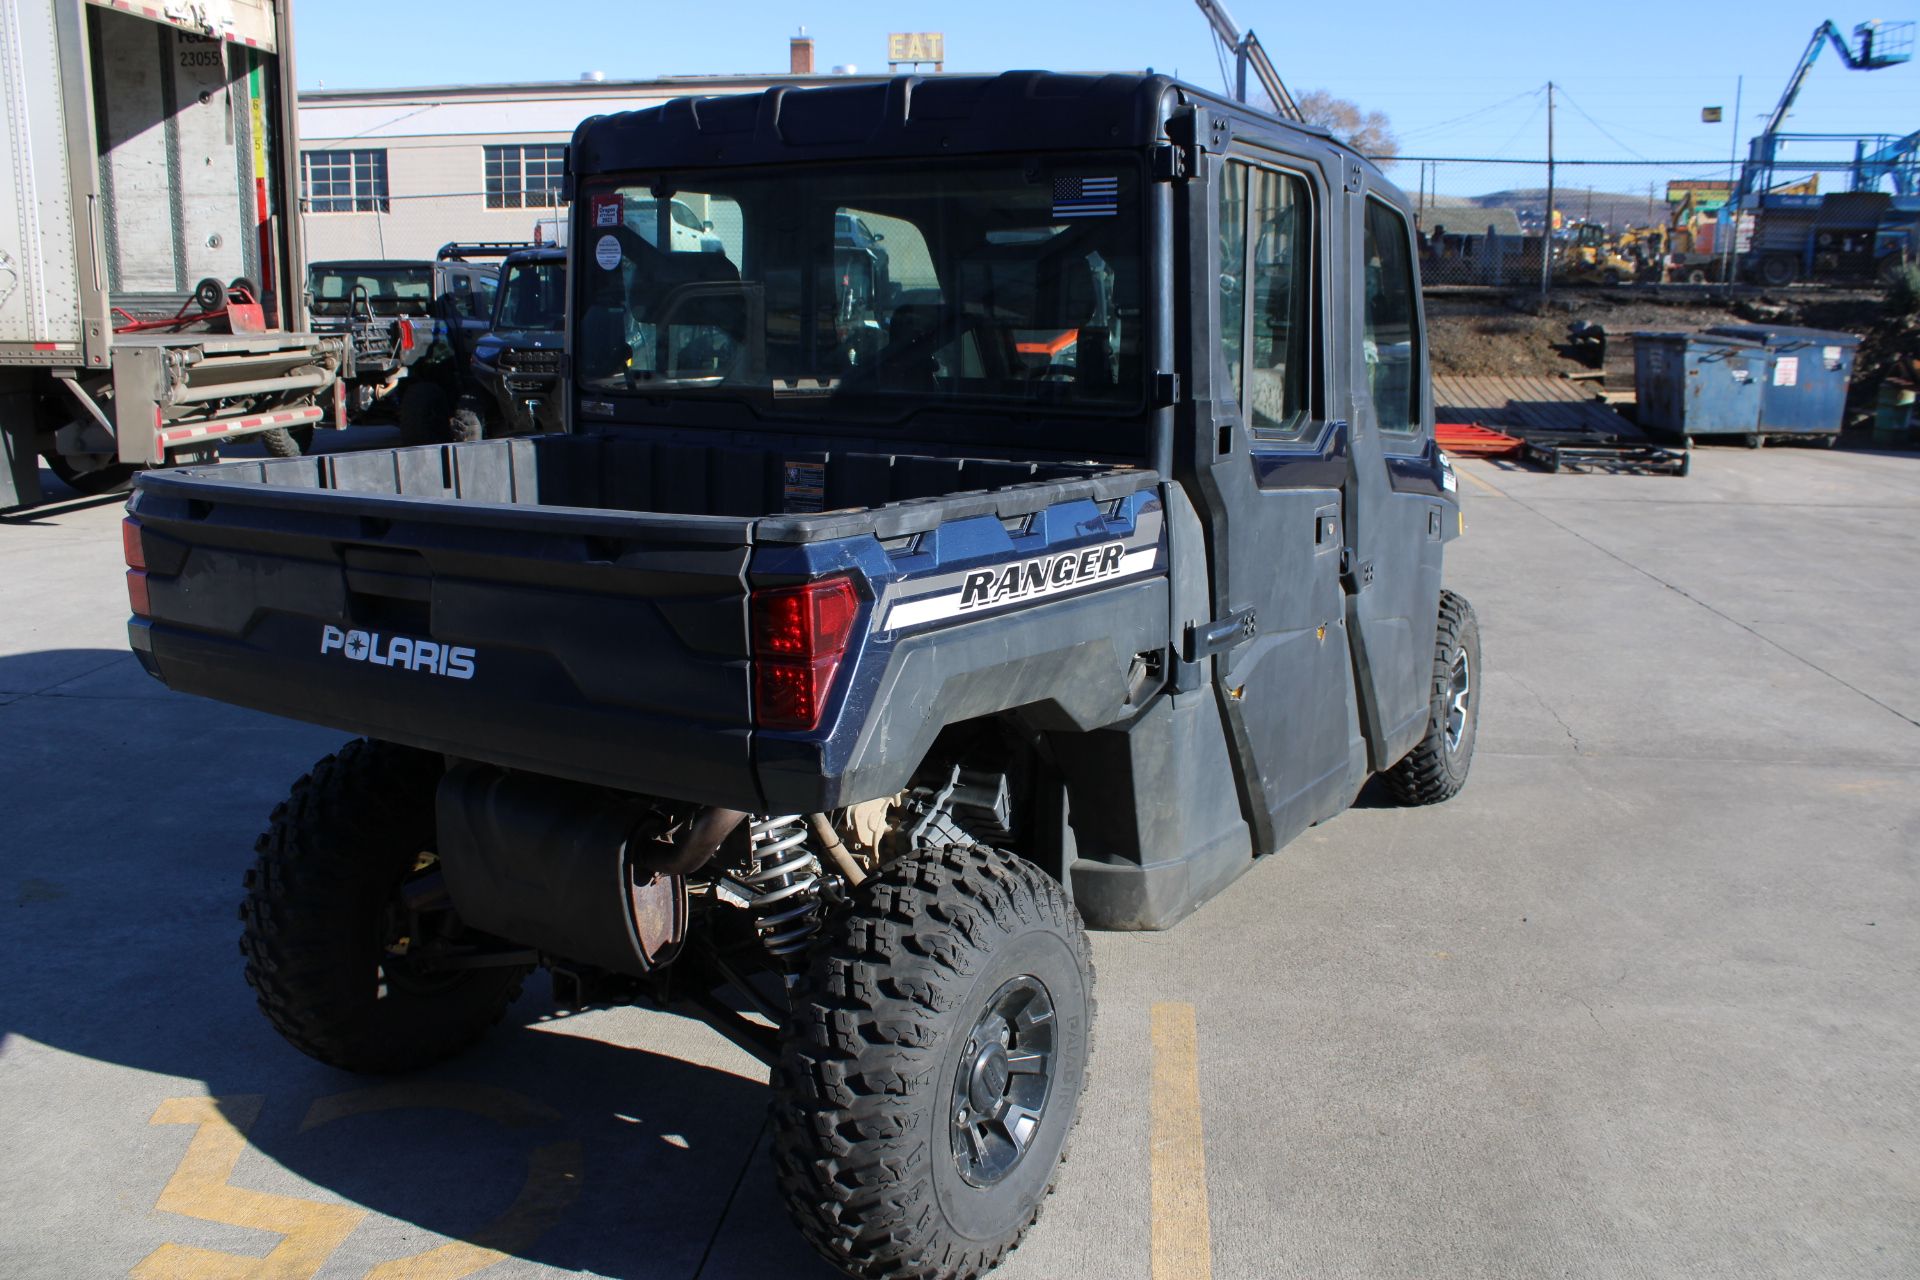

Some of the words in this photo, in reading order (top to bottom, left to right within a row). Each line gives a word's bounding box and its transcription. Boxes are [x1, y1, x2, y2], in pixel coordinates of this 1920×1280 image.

[180, 51, 222, 67] 23055
[891, 34, 941, 59] EAT
[959, 541, 1126, 610] RANGER
[320, 624, 477, 680] POLARIS
